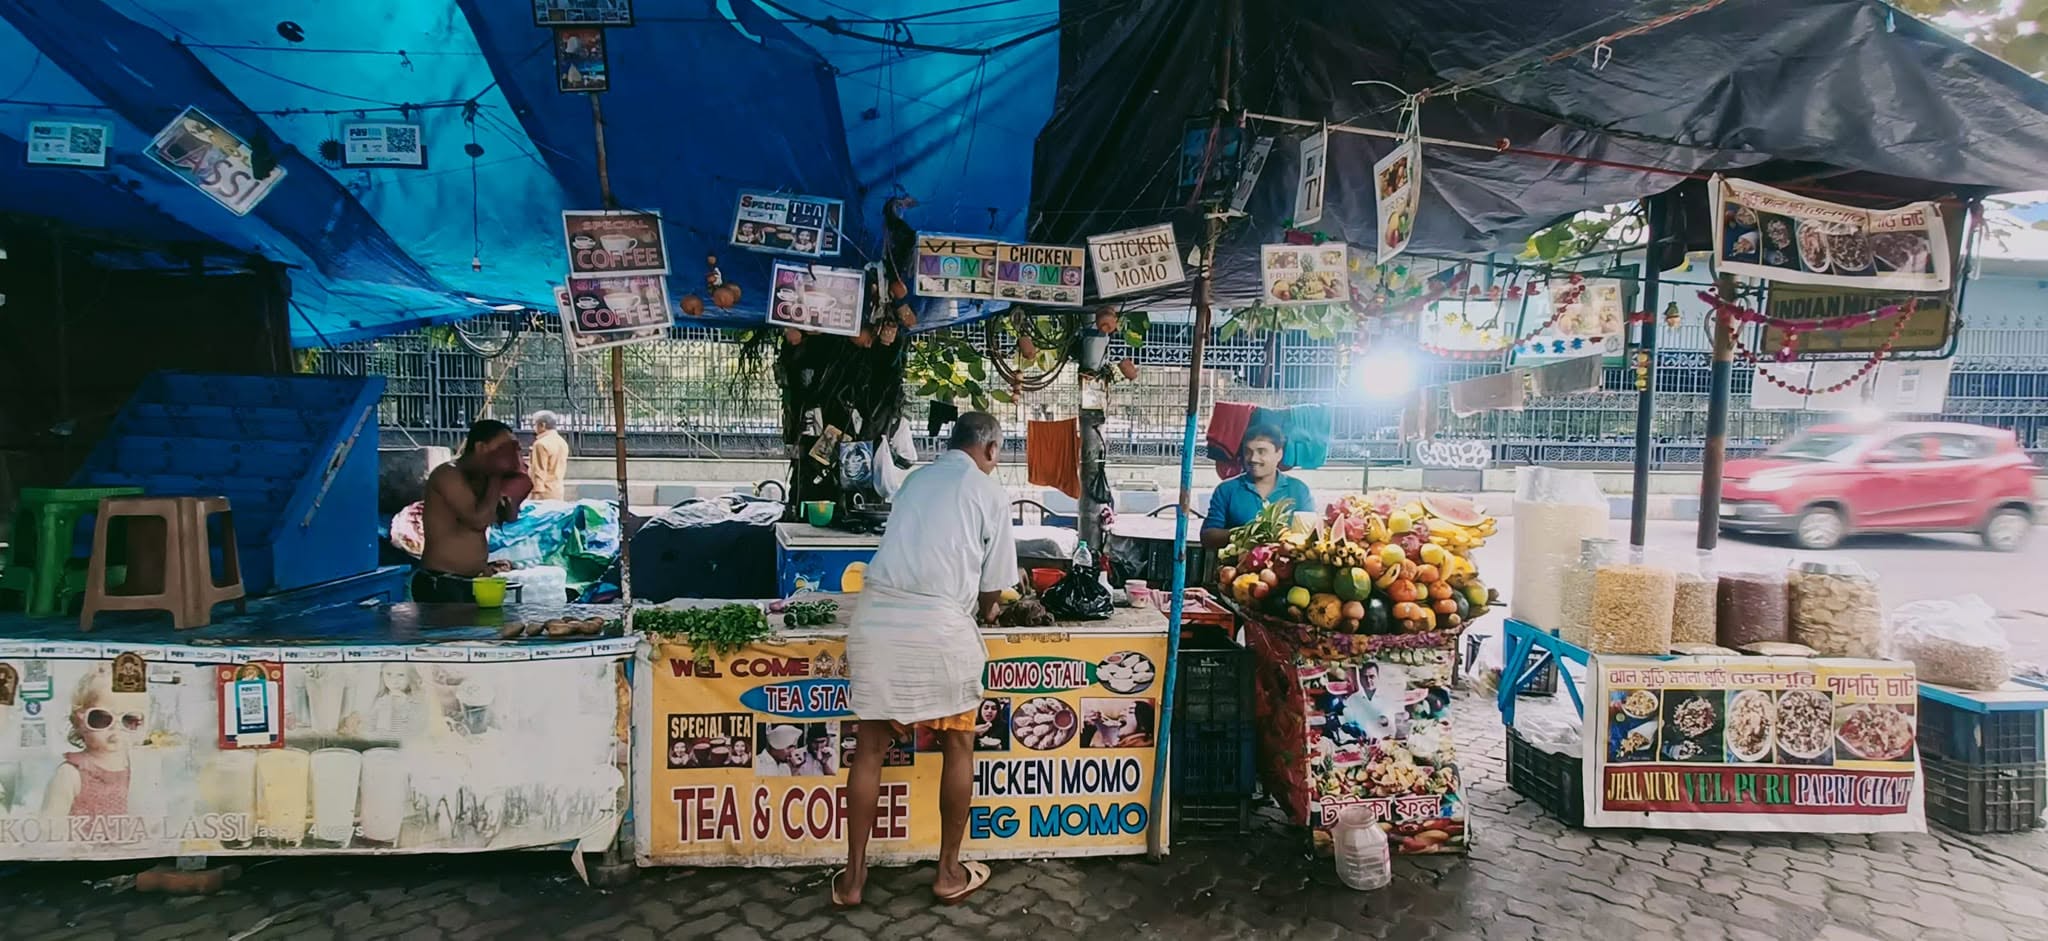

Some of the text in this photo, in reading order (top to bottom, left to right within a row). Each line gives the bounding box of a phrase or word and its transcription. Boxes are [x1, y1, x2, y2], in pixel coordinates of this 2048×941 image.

[157, 143, 260, 204] LASSI
[791, 202, 822, 217] TEA
[582, 220, 648, 231] SPECIAL
[577, 247, 659, 269] COFFEE
[925, 240, 996, 256] VEG
[1009, 246, 1073, 265] CHICKEN
[1098, 233, 1170, 262] CHICKEN
[1114, 263, 1168, 289] MOMO
[581, 302, 663, 328] COFFEE
[777, 301, 852, 327] COFFEE
[730, 657, 810, 678] COME
[989, 661, 1089, 689] MOMO STALL
[1610, 669, 1638, 684] ঝাল
[764, 684, 851, 712] TEA STA
[671, 715, 751, 739] SPECIAL TEA
[972, 757, 1141, 796] HICKEN MOMO
[1607, 771, 1914, 807] JHAL MURI VEL PURI PAPRI CHAT
[672, 784, 908, 842] TEA & COFEE
[1396, 795, 1441, 819] ফল
[0, 811, 251, 844] KOLKATA LASSI
[969, 802, 1149, 840] EG MOMO
